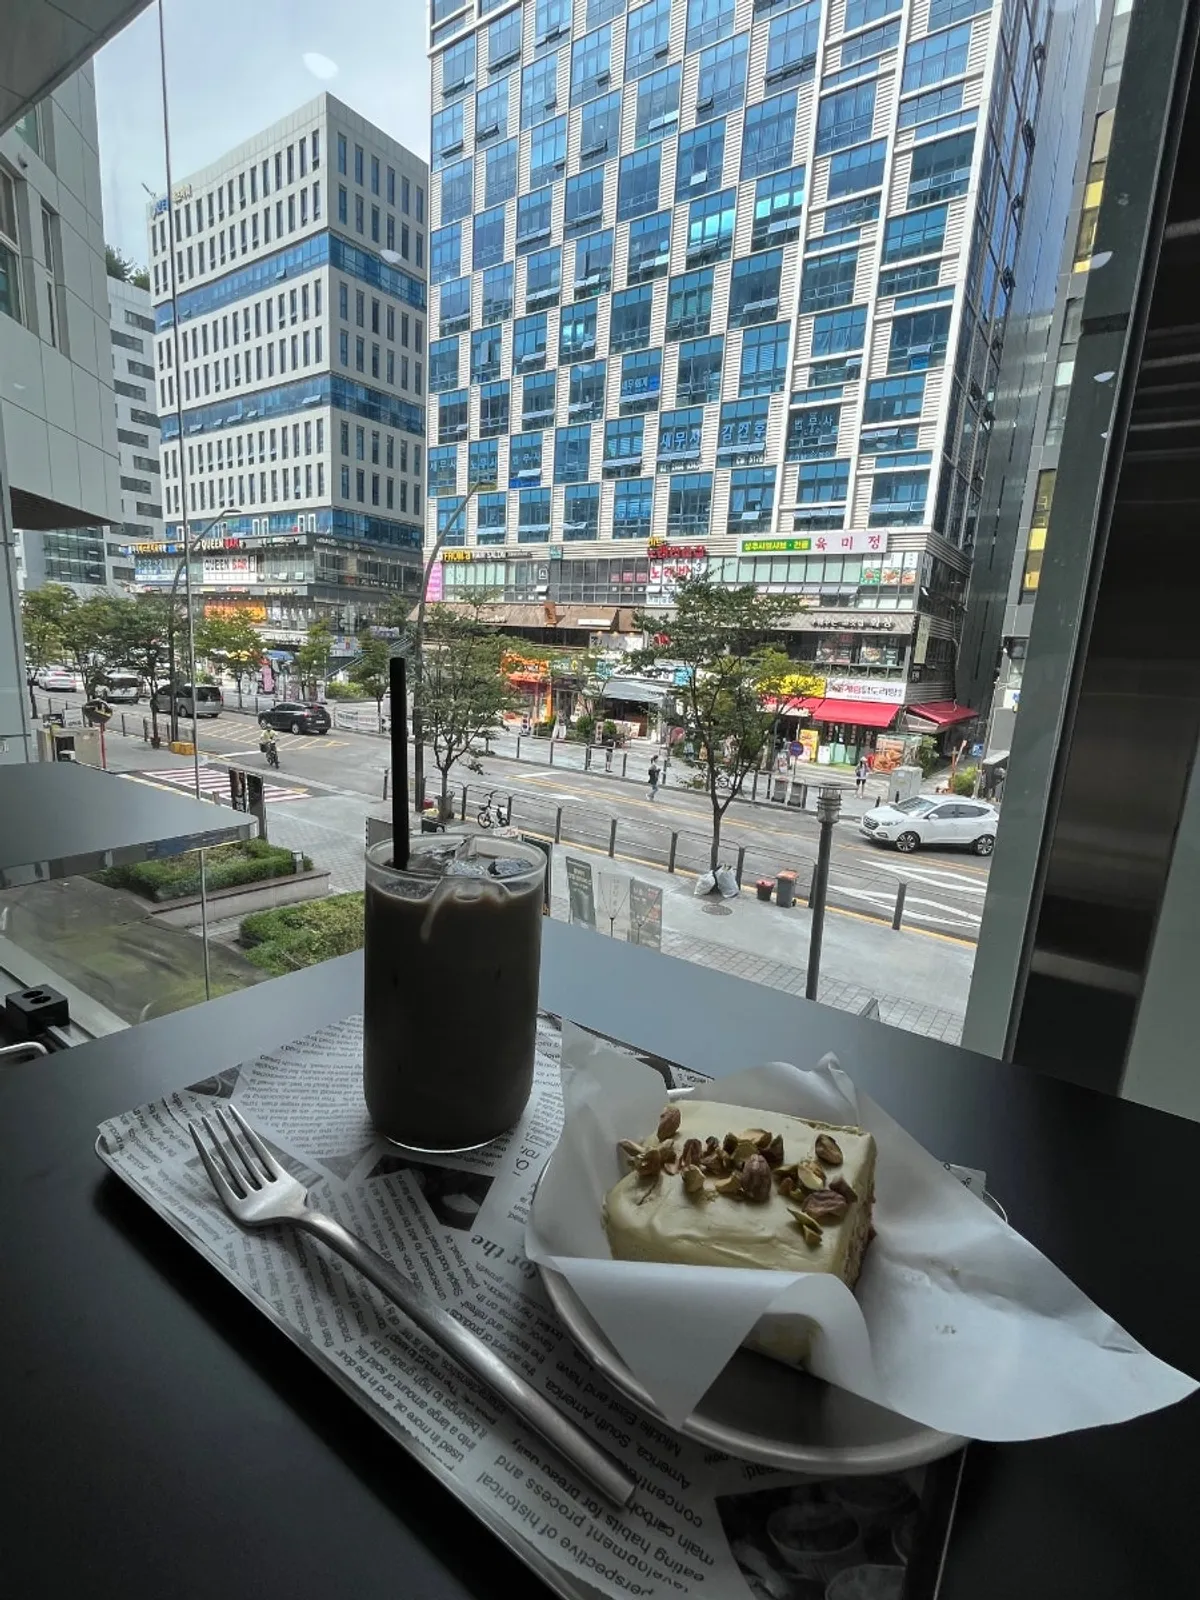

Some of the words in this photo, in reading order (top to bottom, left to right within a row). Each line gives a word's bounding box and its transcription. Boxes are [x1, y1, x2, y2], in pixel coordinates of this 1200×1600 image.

[201, 538, 224, 550] QUEEN
[204, 558, 229, 571] QUEEN
[232, 557, 248, 571] BAR
[425, 1234, 442, 1255] bread
[470, 1233, 505, 1260] the
[436, 1254, 451, 1271] food
[507, 1255, 537, 1280] for
[443, 1270, 465, 1297] Staple
[448, 1308, 484, 1335] products
[486, 1317, 503, 1332] and
[482, 1332, 493, 1342] of
[354, 1365, 370, 1380] the
[366, 1357, 388, 1375] solid
[389, 1354, 417, 1376] grade
[556, 1361, 584, 1388] have
[368, 1376, 380, 1390] in
[382, 1373, 396, 1382] of
[413, 1375, 435, 1394] high
[374, 1385, 395, 1401] and
[394, 1380, 428, 1410] amount
[433, 1391, 444, 1402] to
[545, 1376, 595, 1420] America,
[583, 1383, 609, 1403] and
[407, 1411, 430, 1434] more
[427, 1408, 450, 1431] large
[442, 1399, 480, 1433] belongs
[608, 1400, 638, 1426] East
[430, 1431, 441, 1445] in
[449, 1425, 459, 1436] a
[594, 1416, 631, 1449] South
[640, 1420, 682, 1458] Middle
[437, 1440, 465, 1463] used
[457, 1433, 477, 1452] into
[493, 1455, 524, 1480] and
[476, 1472, 541, 1529] historical
[525, 1478, 586, 1529] process
[581, 1498, 604, 1519] for
[538, 1524, 558, 1539] of
[605, 1514, 651, 1555] habits
[677, 1534, 714, 1566] main
[654, 1547, 704, 1582] eating
